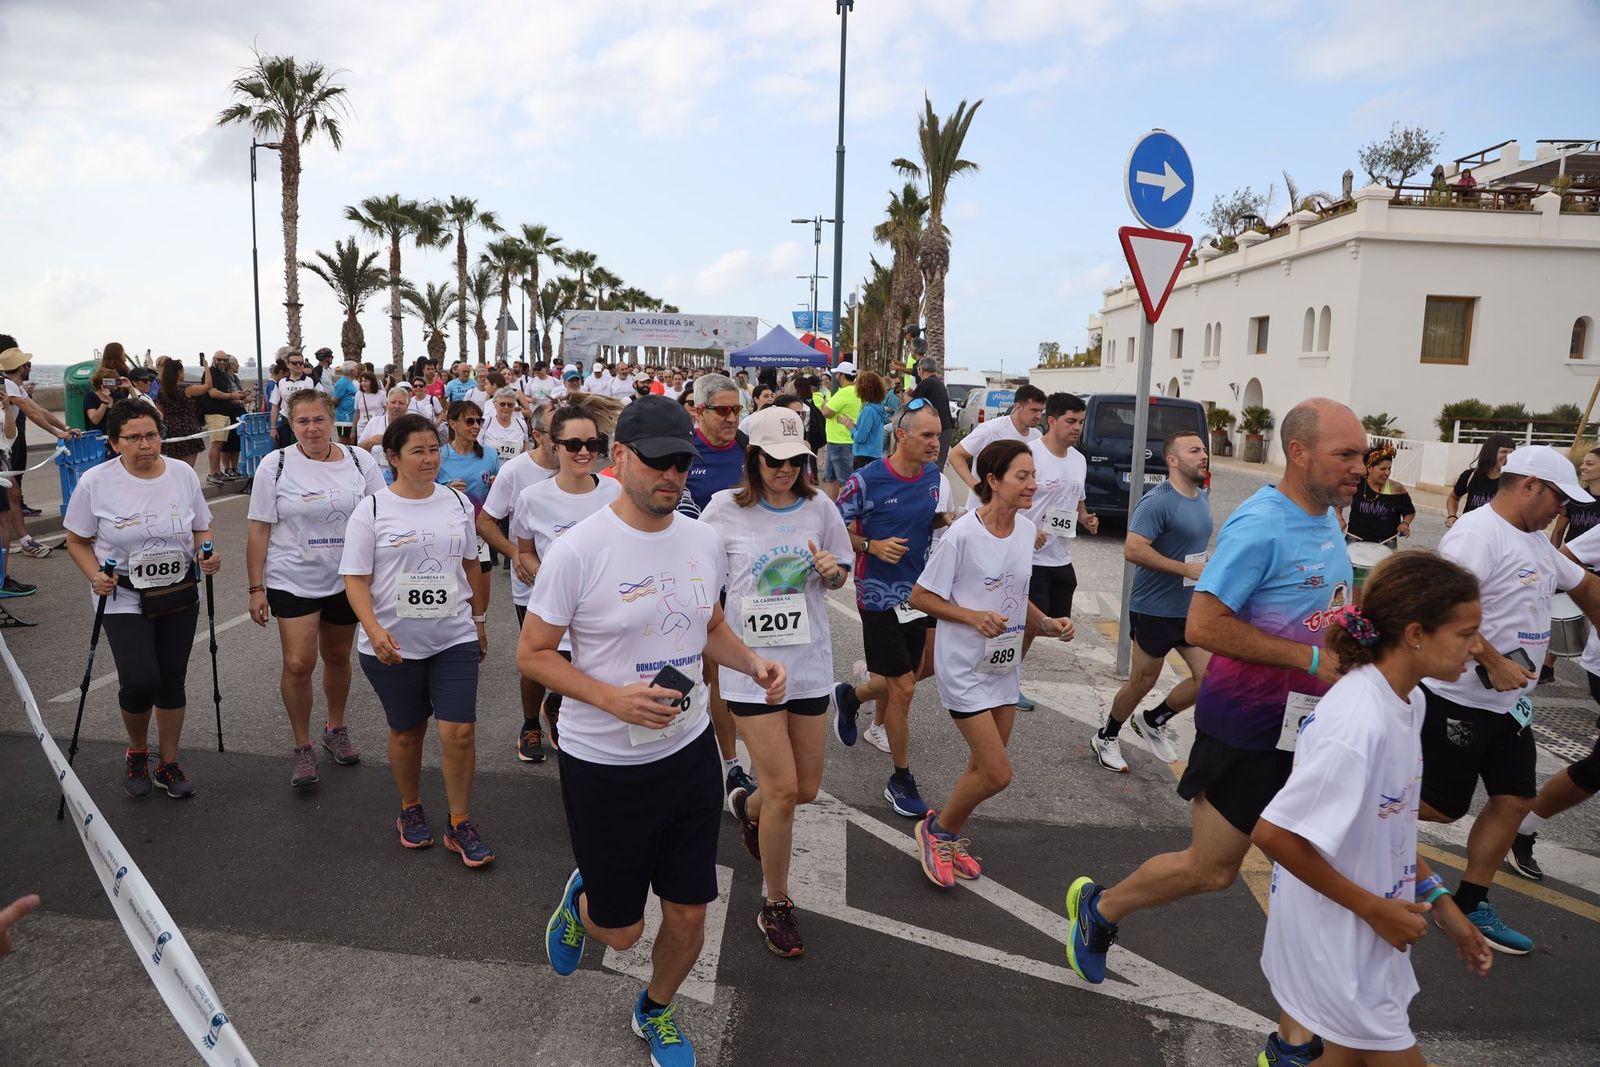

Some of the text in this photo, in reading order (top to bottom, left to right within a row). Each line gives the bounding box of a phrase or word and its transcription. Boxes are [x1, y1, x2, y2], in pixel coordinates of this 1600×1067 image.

[625, 317, 695, 327] 3A CARRERA 5K
[780, 418, 799, 436] M
[500, 446, 515, 454] 136
[691, 467, 707, 475] vive
[1051, 517, 1072, 530] 345
[751, 553, 770, 577] POR
[769, 545, 789, 556] TU
[134, 561, 181, 578] 1088
[408, 589, 448, 605] 863
[747, 611, 802, 633] 1207
[990, 647, 1015, 664] 889
